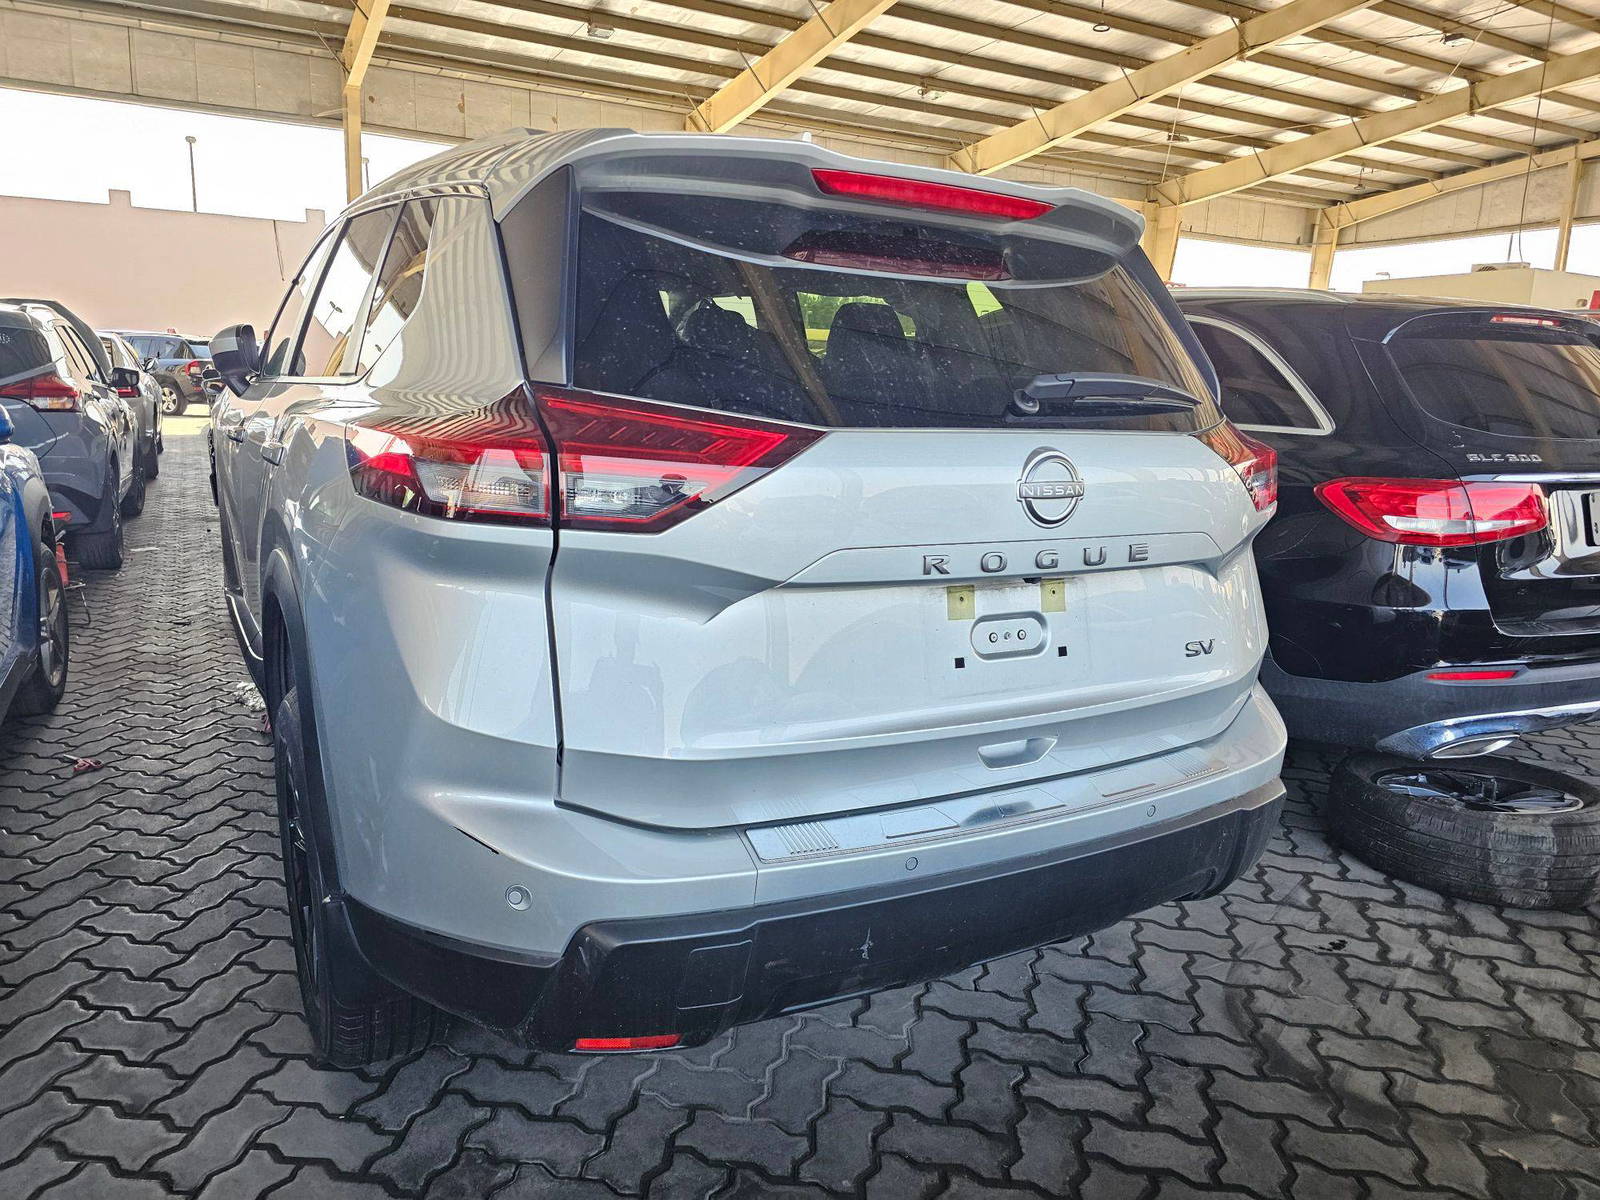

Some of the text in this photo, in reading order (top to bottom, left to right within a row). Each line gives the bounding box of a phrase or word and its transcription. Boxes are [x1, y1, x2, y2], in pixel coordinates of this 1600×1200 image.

[1022, 484, 1084, 496] NISSAN
[922, 542, 1149, 575] ROGUE
[1185, 638, 1215, 657] SV
